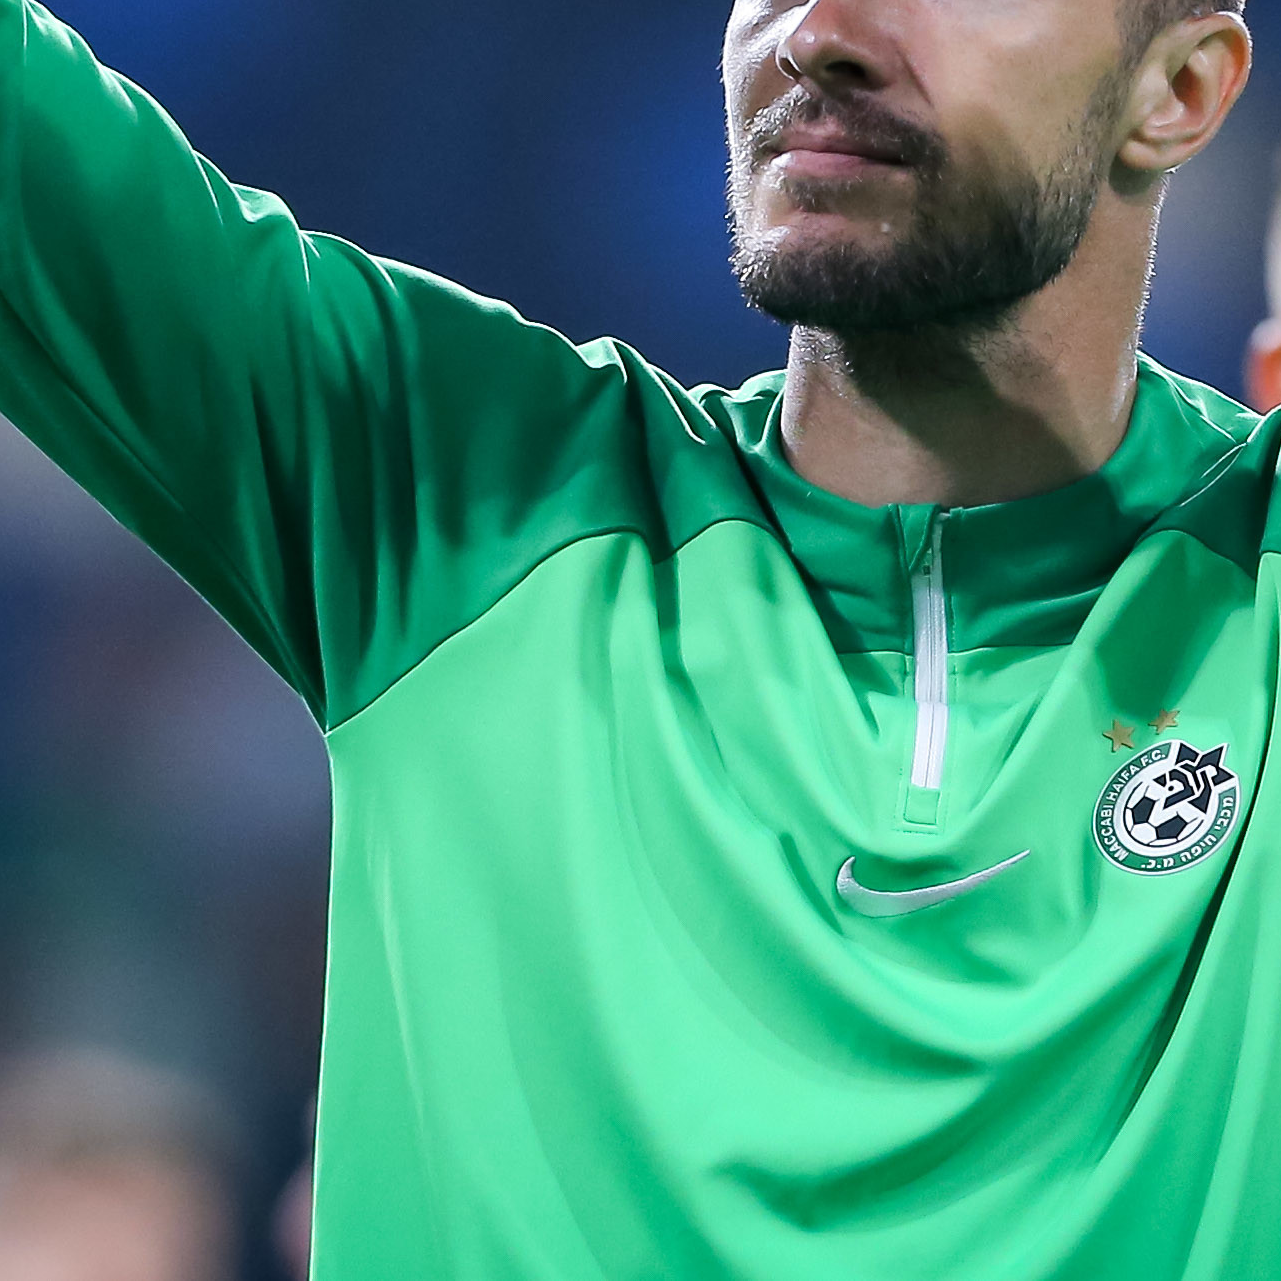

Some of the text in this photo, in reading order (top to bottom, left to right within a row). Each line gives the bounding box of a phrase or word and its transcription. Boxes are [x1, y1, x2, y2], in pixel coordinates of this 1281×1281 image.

[1100, 750, 1166, 862] MACCABI HAIFA F.C.
[1215, 796, 1234, 832] מכבי
[1179, 835, 1218, 863] חיפה
